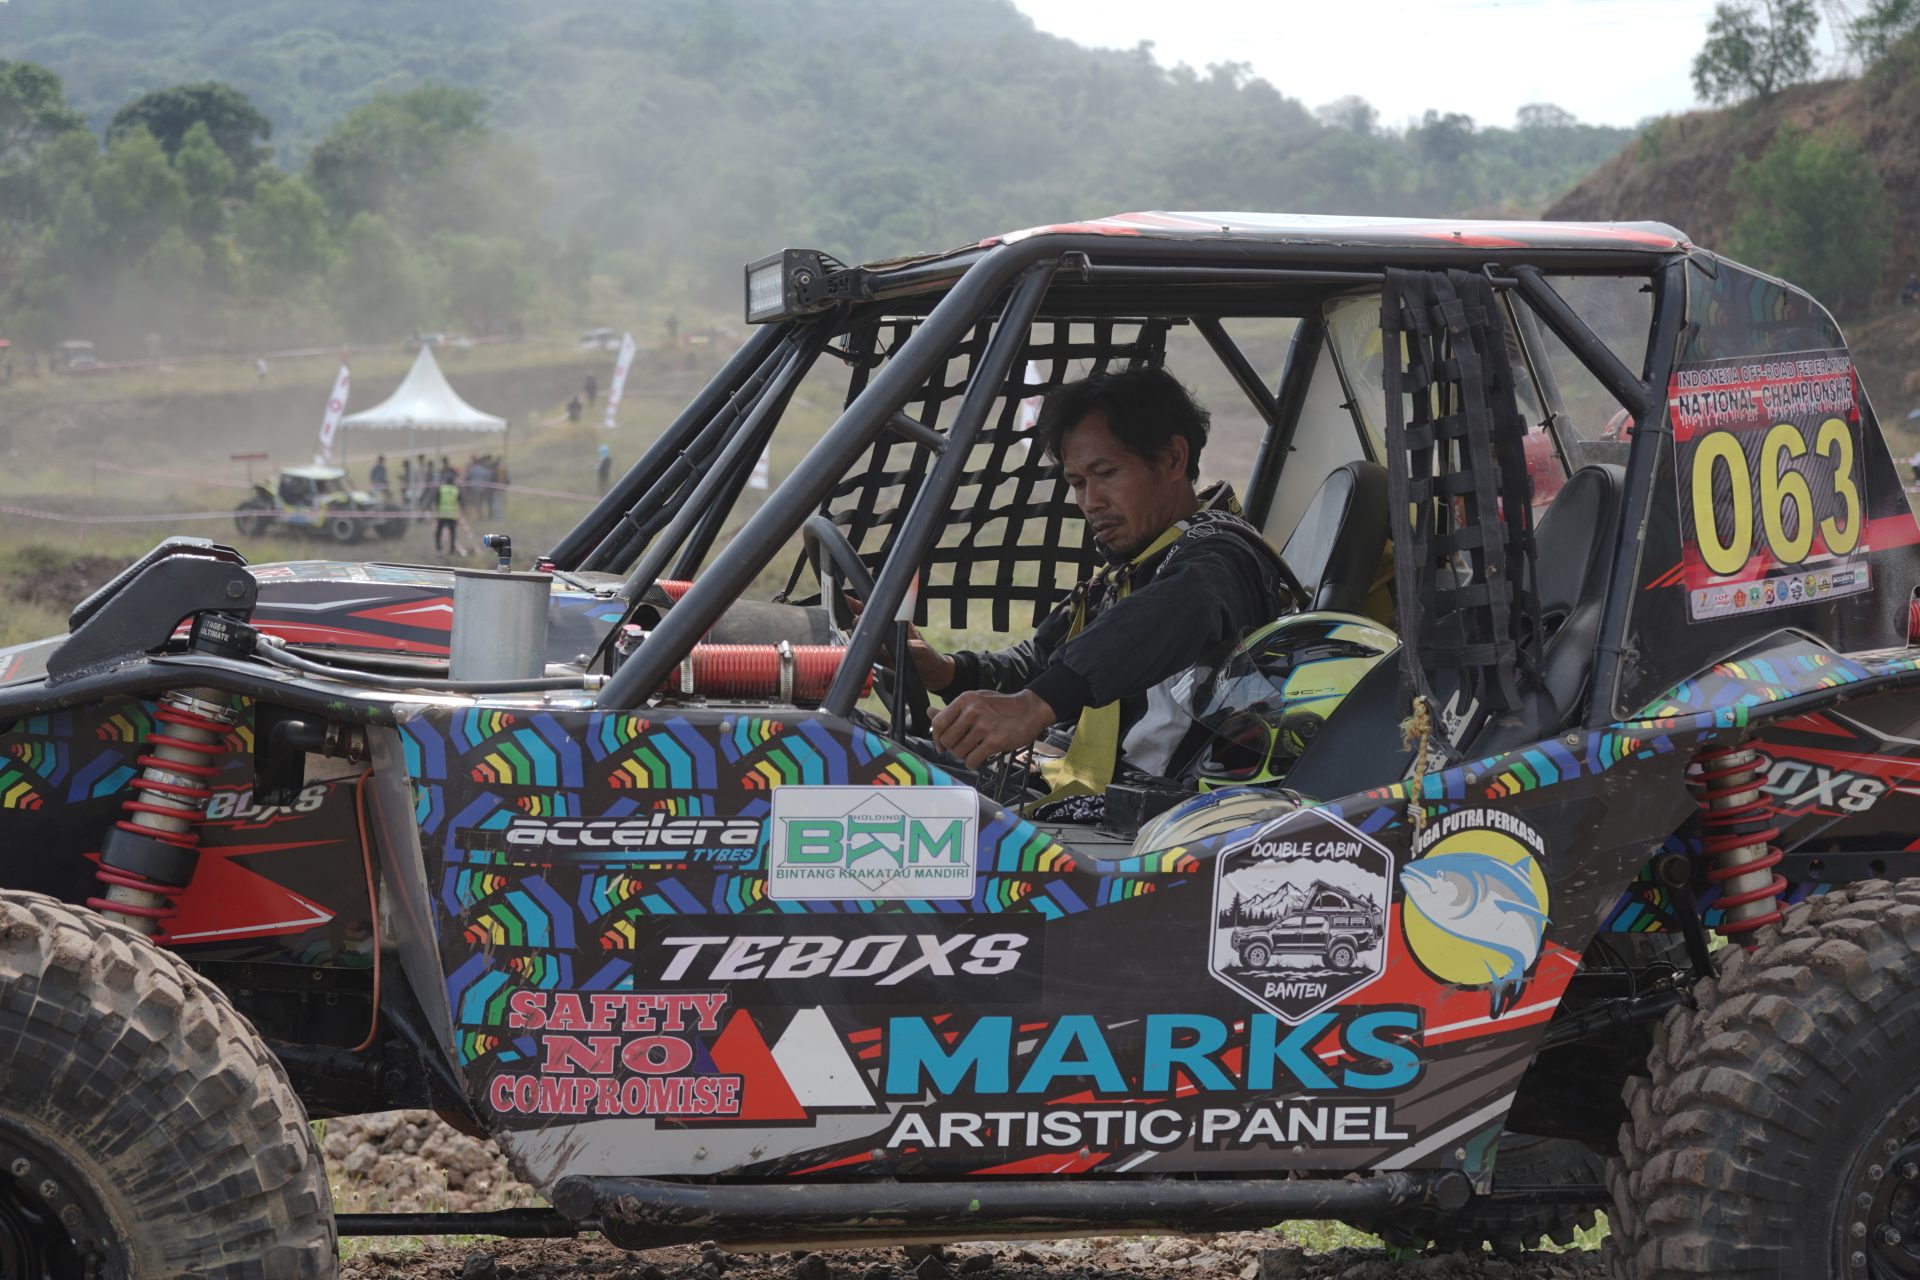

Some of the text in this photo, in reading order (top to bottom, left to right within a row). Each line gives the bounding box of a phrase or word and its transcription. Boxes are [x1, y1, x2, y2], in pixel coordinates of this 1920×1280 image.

[1678, 356, 1850, 388] INDONESIA OFF-ROAD FEDERATION
[1678, 376, 1852, 418] NATIONAL CHAMPIONSHIP
[1691, 418, 1861, 575] 063
[200, 627, 230, 641] ULTIMATE
[506, 813, 760, 846] accelera
[1410, 808, 1546, 860] IGA PUTRA PERKASA
[692, 848, 755, 862] TYRES
[1251, 841, 1363, 860] DOUBLE CABIN
[776, 868, 969, 880] BINTANG KRAKATAU MANDIRI
[660, 932, 1029, 986] TEBOXS
[1264, 981, 1328, 1000] BANTEN
[509, 991, 728, 1032] SAFETY
[541, 1035, 695, 1074] NO
[885, 1012, 1421, 1096] MARKS
[490, 1076, 741, 1116] COMPROMISE
[887, 1105, 1410, 1149] ARTISTIC PANEL
